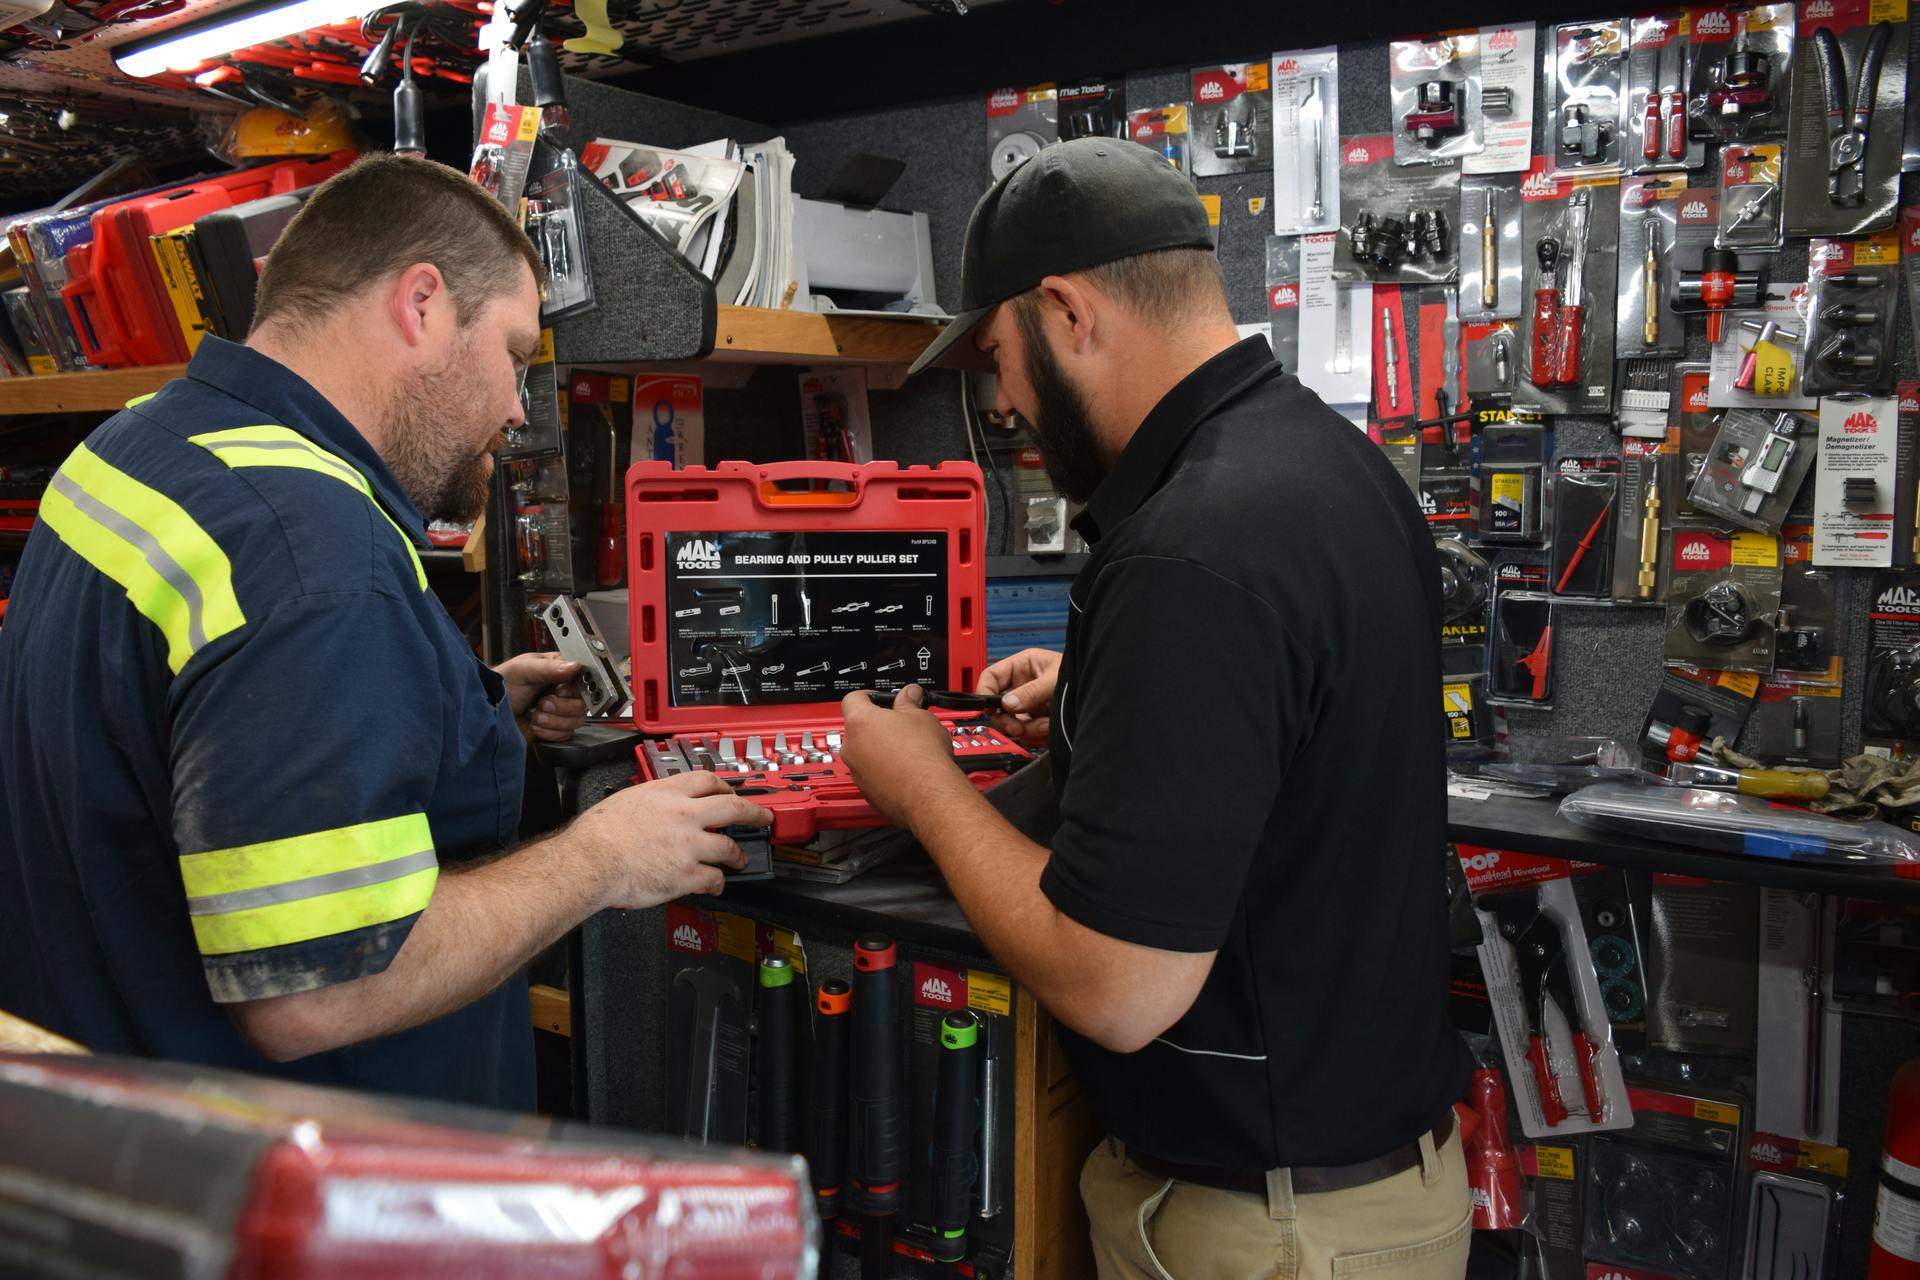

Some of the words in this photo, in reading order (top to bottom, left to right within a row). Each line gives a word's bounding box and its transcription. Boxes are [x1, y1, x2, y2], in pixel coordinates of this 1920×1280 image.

[1806, 0, 1834, 12] MAC
[1697, 12, 1730, 26] MAC
[1697, 25, 1730, 34] TOOLS
[1081, 84, 1105, 94] Tools
[1200, 82, 1224, 94] MAC
[1523, 188, 1558, 197] TOOLS
[1682, 201, 1708, 214] MAC
[1844, 412, 1878, 428] MAC
[1560, 459, 1581, 468] MAC
[676, 539, 721, 561] MAC
[1682, 542, 1710, 555] MAC
[676, 561, 721, 570] TOOLS
[734, 555, 784, 565] BEARING
[786, 554, 811, 565] AND
[813, 554, 854, 564] PULLEY
[856, 554, 897, 564] PULLER
[898, 554, 919, 564] SET
[1502, 565, 1521, 574] MAC
[1877, 586, 1920, 605] MAC
[1877, 605, 1920, 613] TOOLS
[1461, 852, 1500, 872] POP
[673, 925, 701, 944] MAC
[674, 940, 701, 950] TOOLS
[922, 978, 952, 997] MAC
[921, 991, 952, 1003] TOOLS
[1752, 1143, 1781, 1158] MAC
